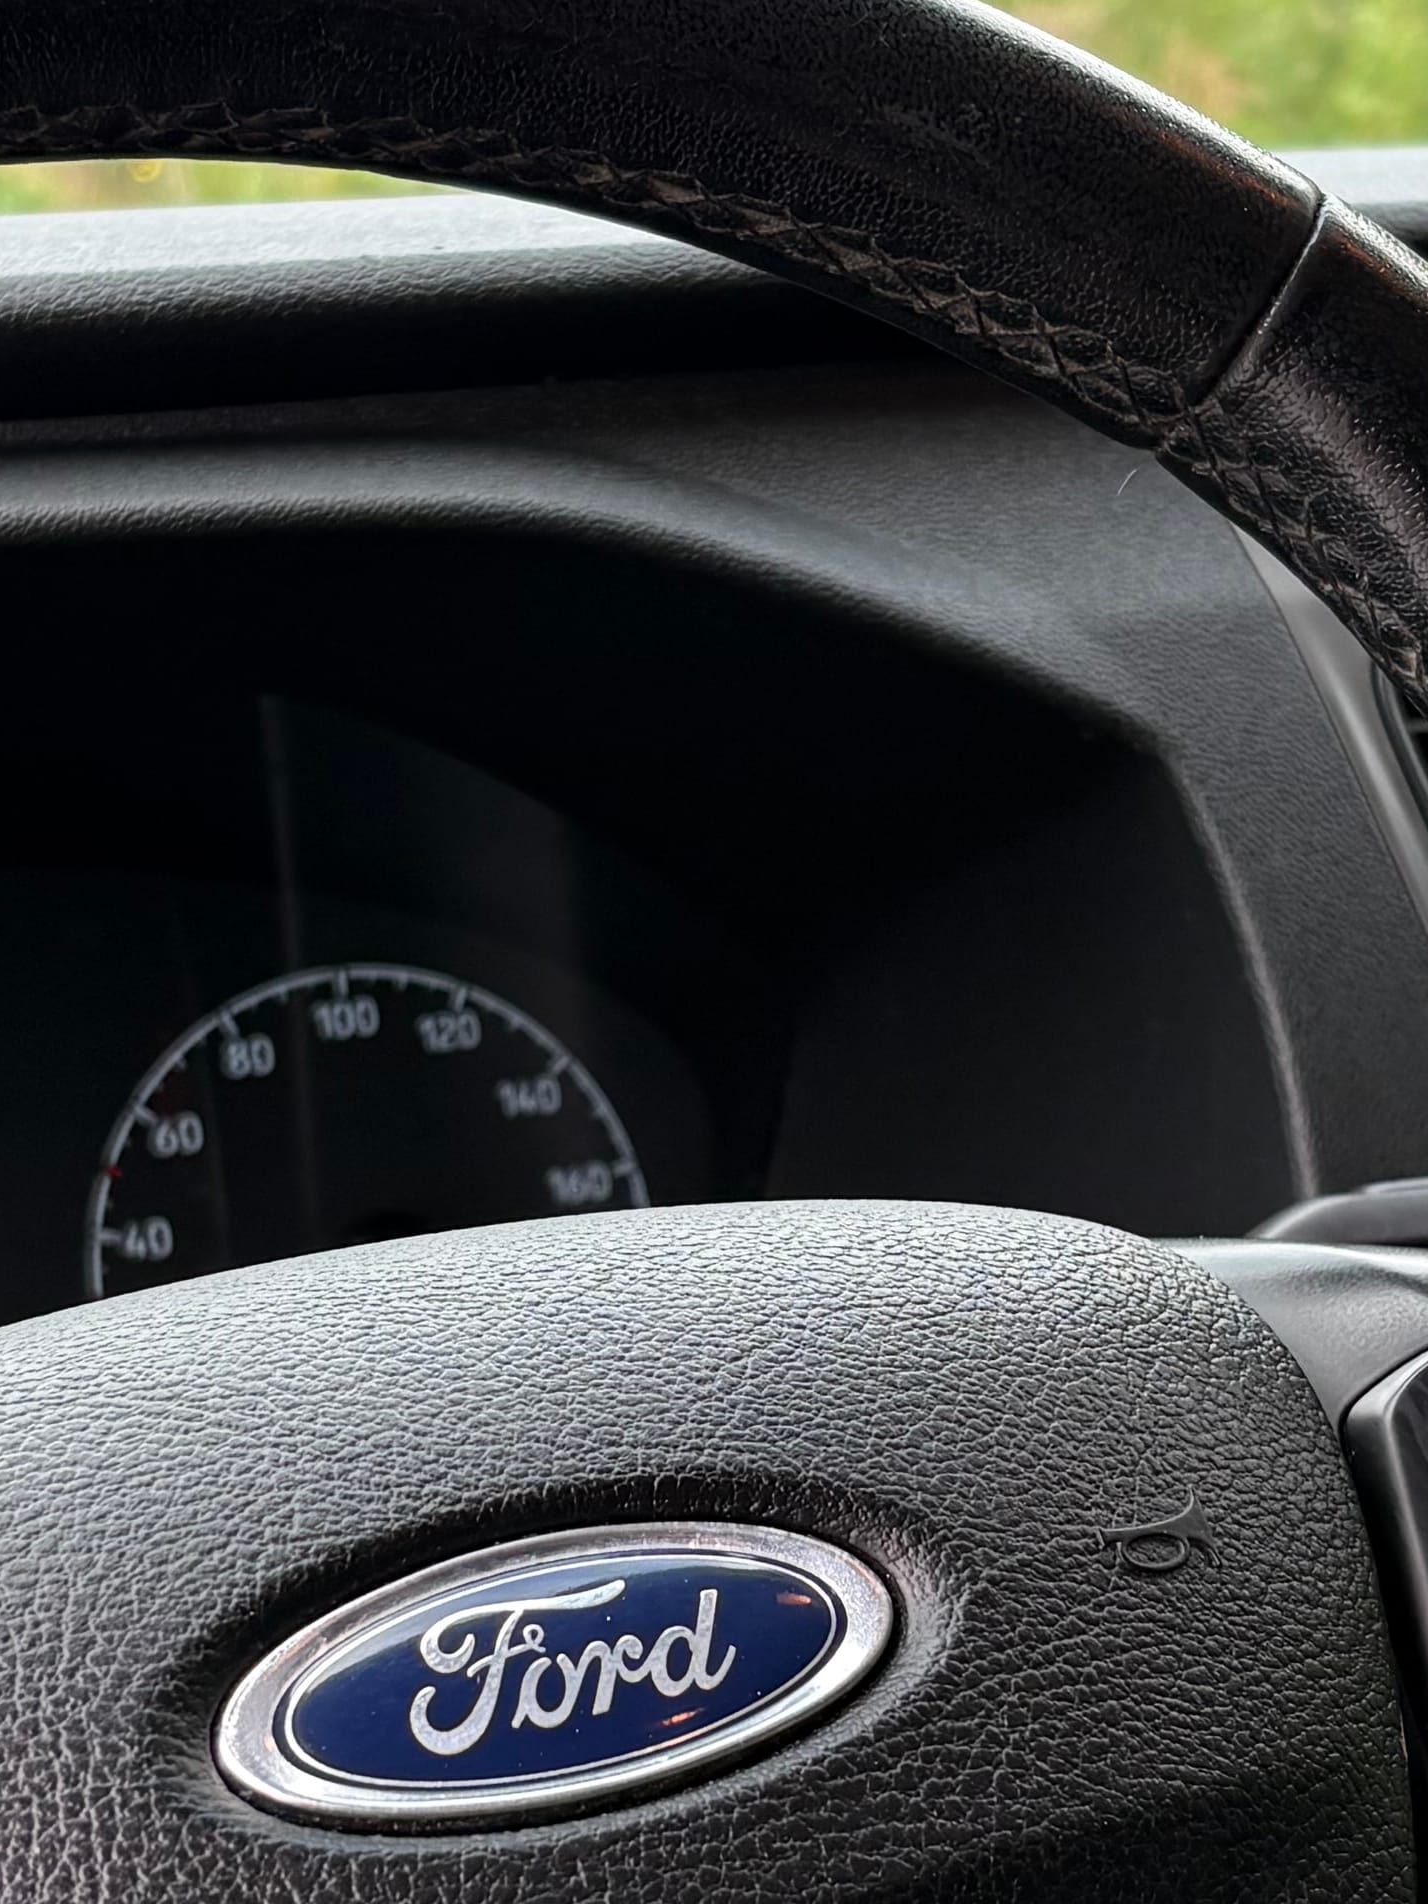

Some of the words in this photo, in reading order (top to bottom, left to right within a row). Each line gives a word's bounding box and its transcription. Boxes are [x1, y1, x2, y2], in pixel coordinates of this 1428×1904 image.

[314, 999, 380, 1039] 100
[417, 1011, 481, 1054] 120
[223, 1034, 274, 1078] 80
[500, 1076, 562, 1116] 140
[149, 1110, 204, 1157] 60
[548, 1162, 614, 1204] 160
[122, 1218, 173, 1260] 40
[408, 1579, 737, 1756] Ford
